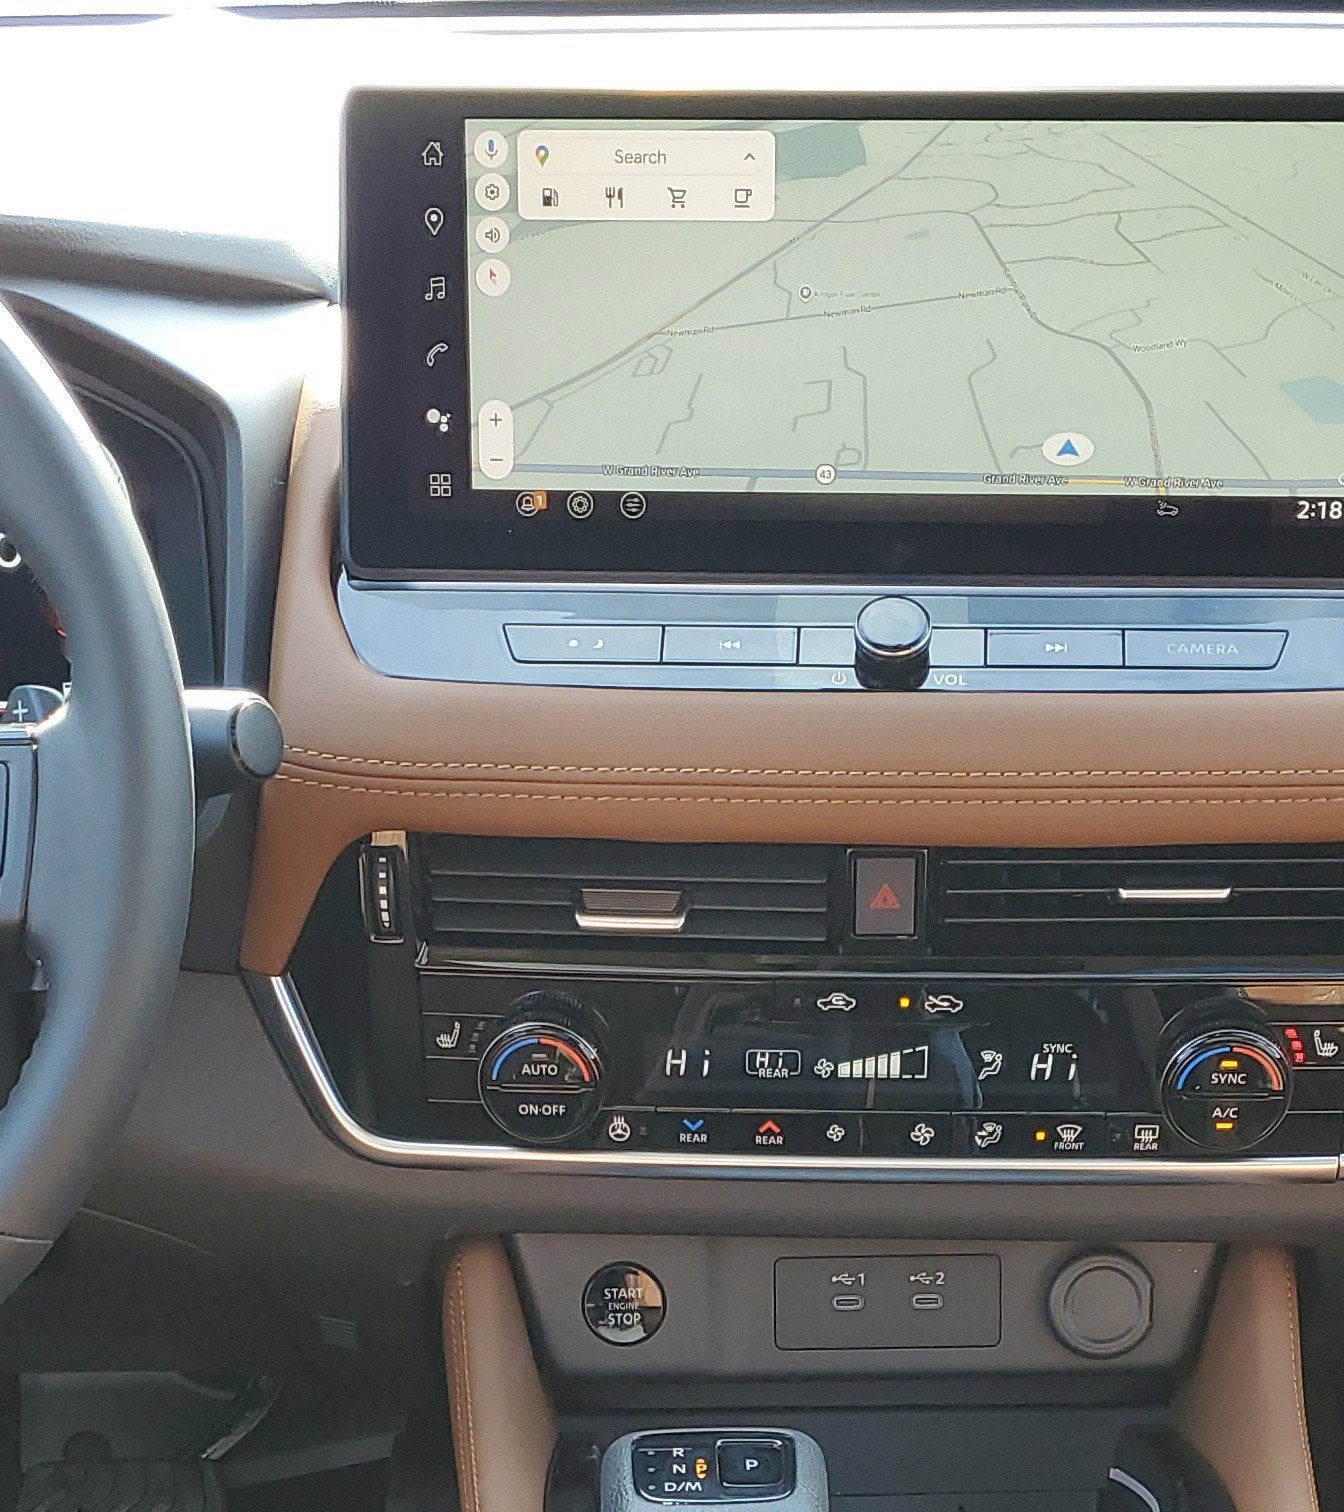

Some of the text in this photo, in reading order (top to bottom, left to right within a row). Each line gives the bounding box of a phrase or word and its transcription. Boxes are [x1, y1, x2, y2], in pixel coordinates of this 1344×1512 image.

[614, 149, 667, 165] Search
[861, 305, 872, 314] Rd
[616, 465, 649, 476] Grand
[650, 466, 677, 477] River
[678, 467, 700, 477] Ave
[819, 469, 832, 480] 43
[983, 473, 1069, 486] Grand River Ave
[1124, 476, 1223, 488] W Grand River Ave
[1296, 501, 1343, 520] 2:18
[1166, 642, 1239, 656] CAMERA
[933, 673, 967, 687] VOL
[1043, 1043, 1074, 1054] SYNC
[521, 1064, 558, 1076] AUTO
[758, 1068, 788, 1078] REAR
[1211, 1073, 1247, 1086] SYNC
[1212, 1107, 1239, 1119] A/C
[679, 1132, 708, 1143] REAR
[755, 1134, 784, 1145] REAR
[1054, 1141, 1086, 1151] FRONT
[1133, 1141, 1158, 1151] REAR
[604, 1288, 643, 1299] START
[608, 1302, 638, 1310] ENGINE
[608, 1313, 641, 1325] STOP
[672, 1448, 684, 1457] R
[673, 1464, 686, 1474] N
[746, 1460, 758, 1470] P
[664, 1482, 703, 1492] D/M
